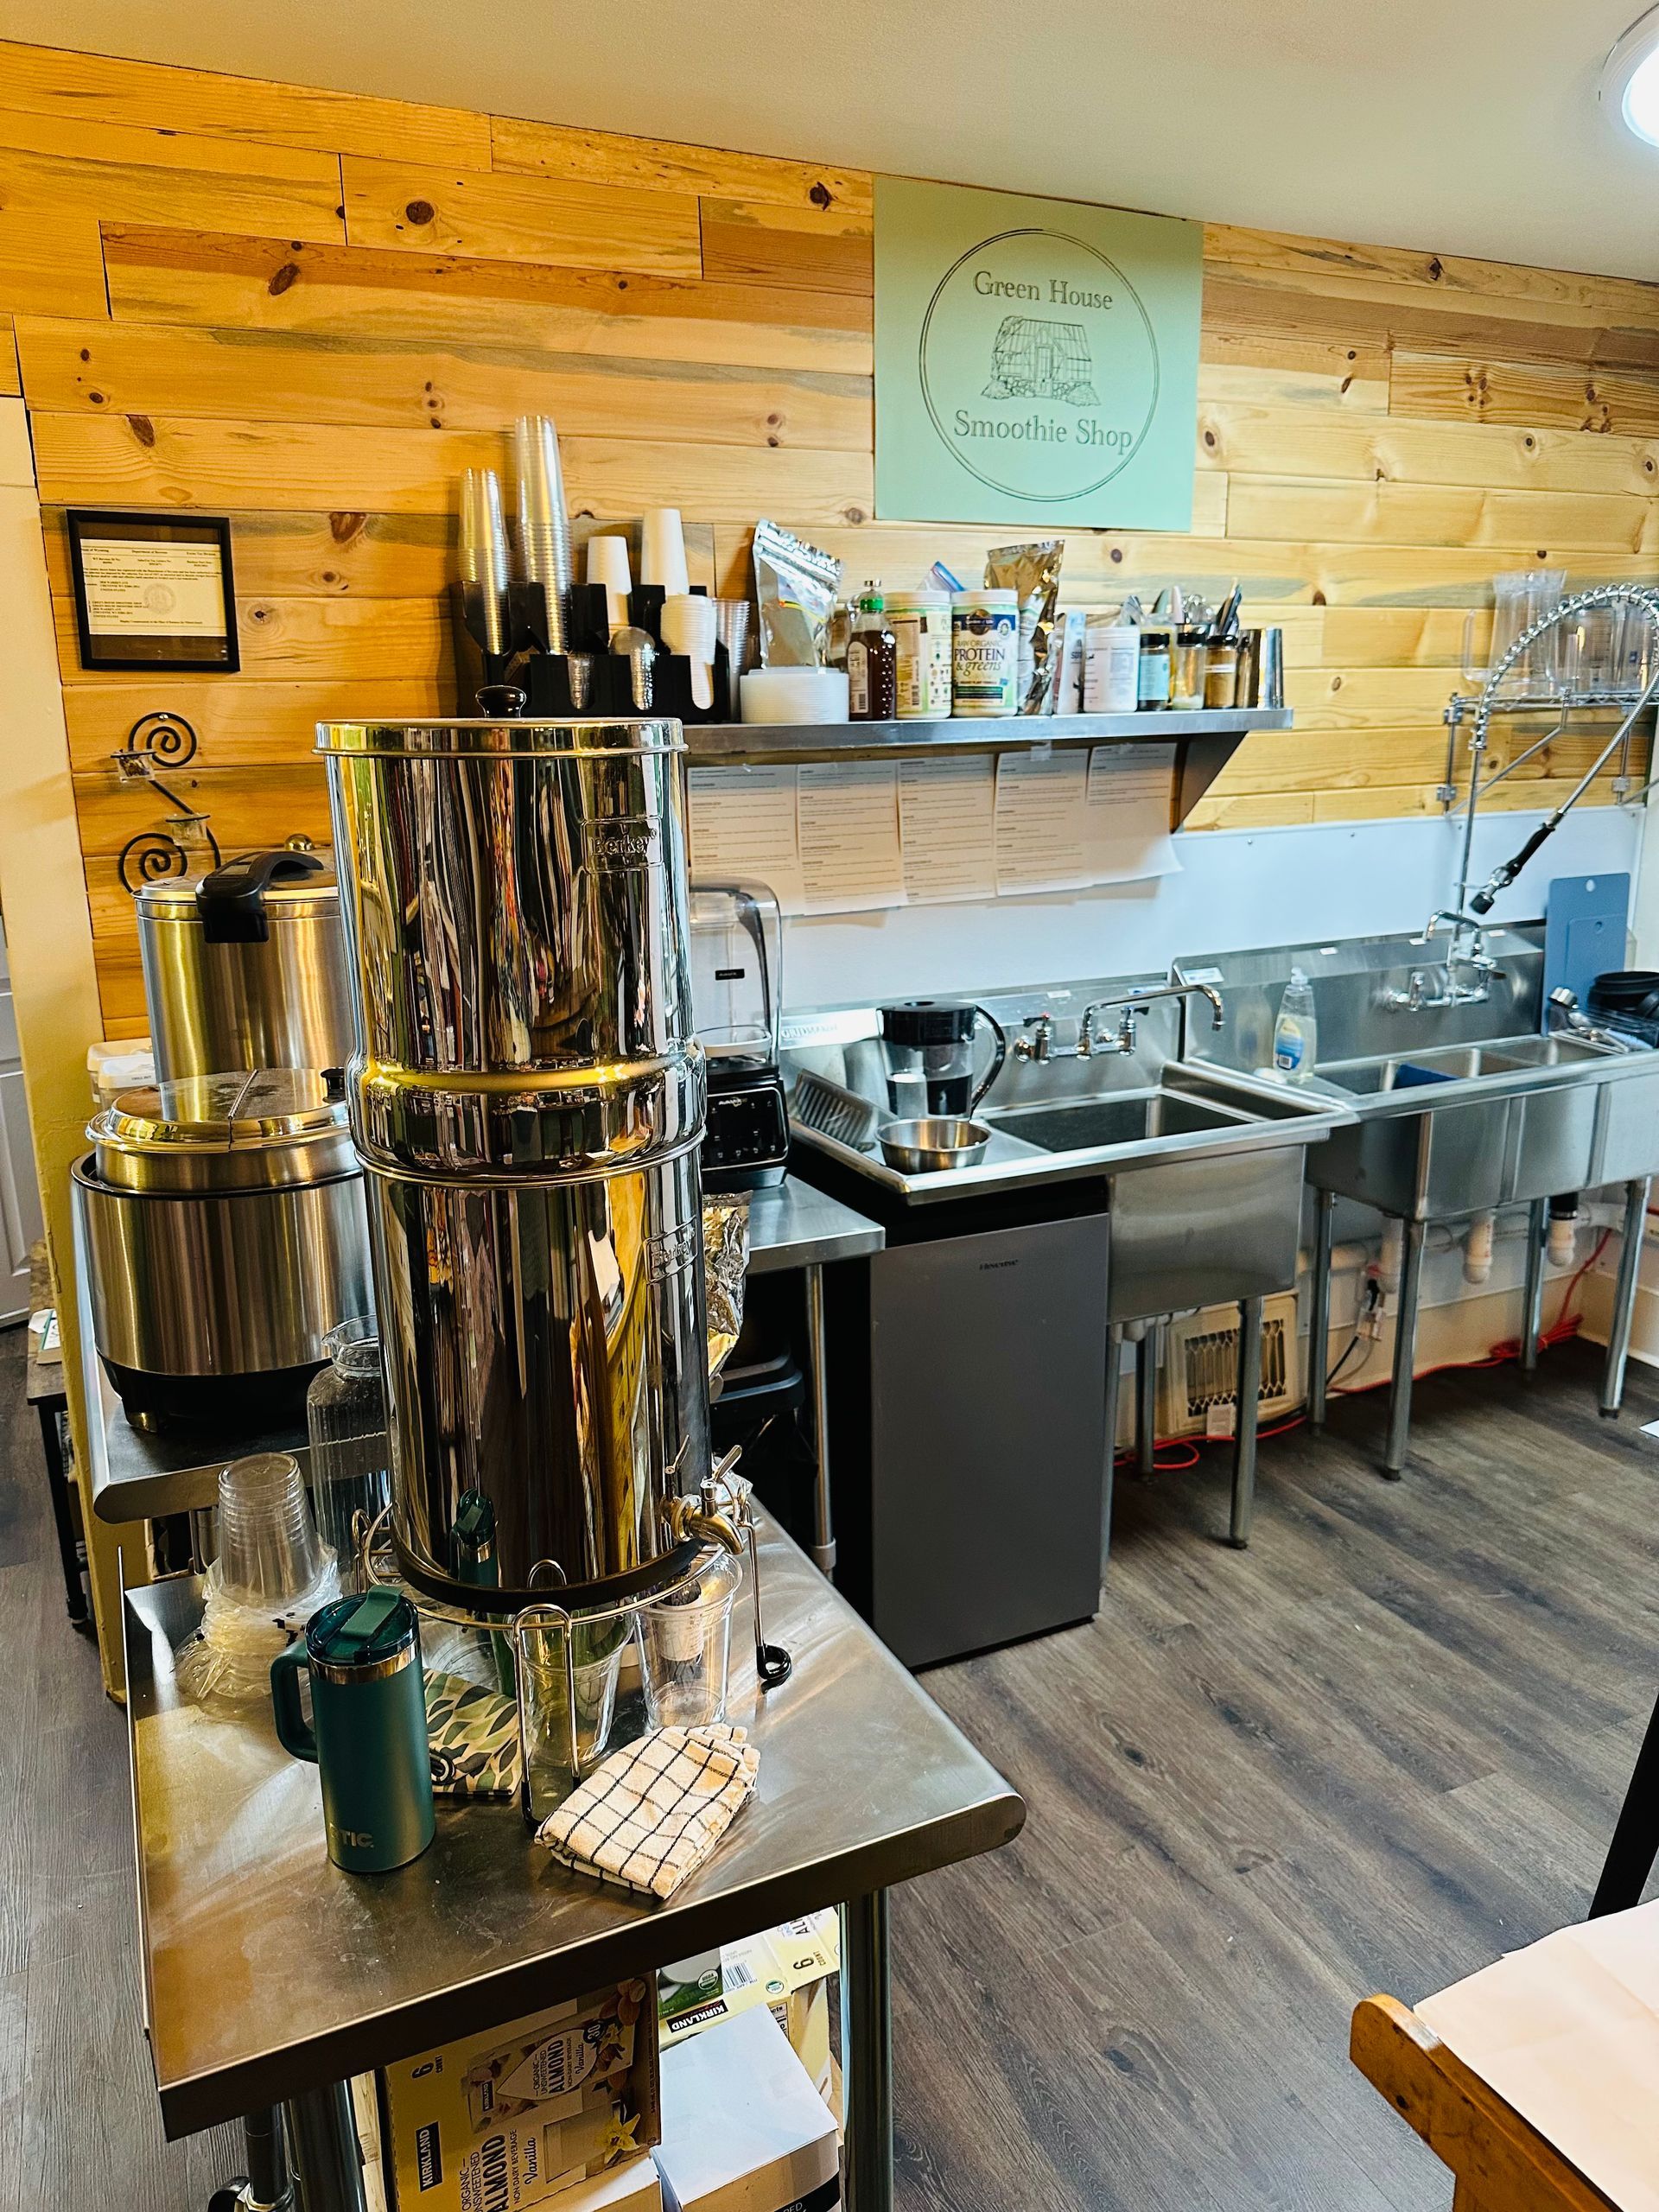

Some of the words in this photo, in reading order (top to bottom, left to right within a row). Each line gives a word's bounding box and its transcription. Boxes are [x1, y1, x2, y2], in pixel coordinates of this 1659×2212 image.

[973, 270, 1040, 301] Green
[1049, 279, 1113, 309] House
[954, 410, 1068, 442] Smoothie
[1076, 418, 1133, 455] Shop
[954, 648, 1006, 661] PROTEIN
[963, 662, 1001, 677] greens
[591, 834, 650, 856] Berkey
[792, 1957, 814, 1970] 6
[588, 2024, 601, 2040] 30
[671, 2005, 725, 2031] KIRKLAND
[411, 2062, 434, 2079] 6
[548, 2039, 565, 2094] ALMOND
[575, 2043, 584, 2074] Vanilla
[419, 2129, 434, 2188] KIRKLAND
[510, 2129, 518, 2165] BEVERAGE
[522, 2137, 538, 2184] Vanilla
[460, 2168, 472, 2211] ORGANIC
[481, 2135, 510, 2212] ALMOND
